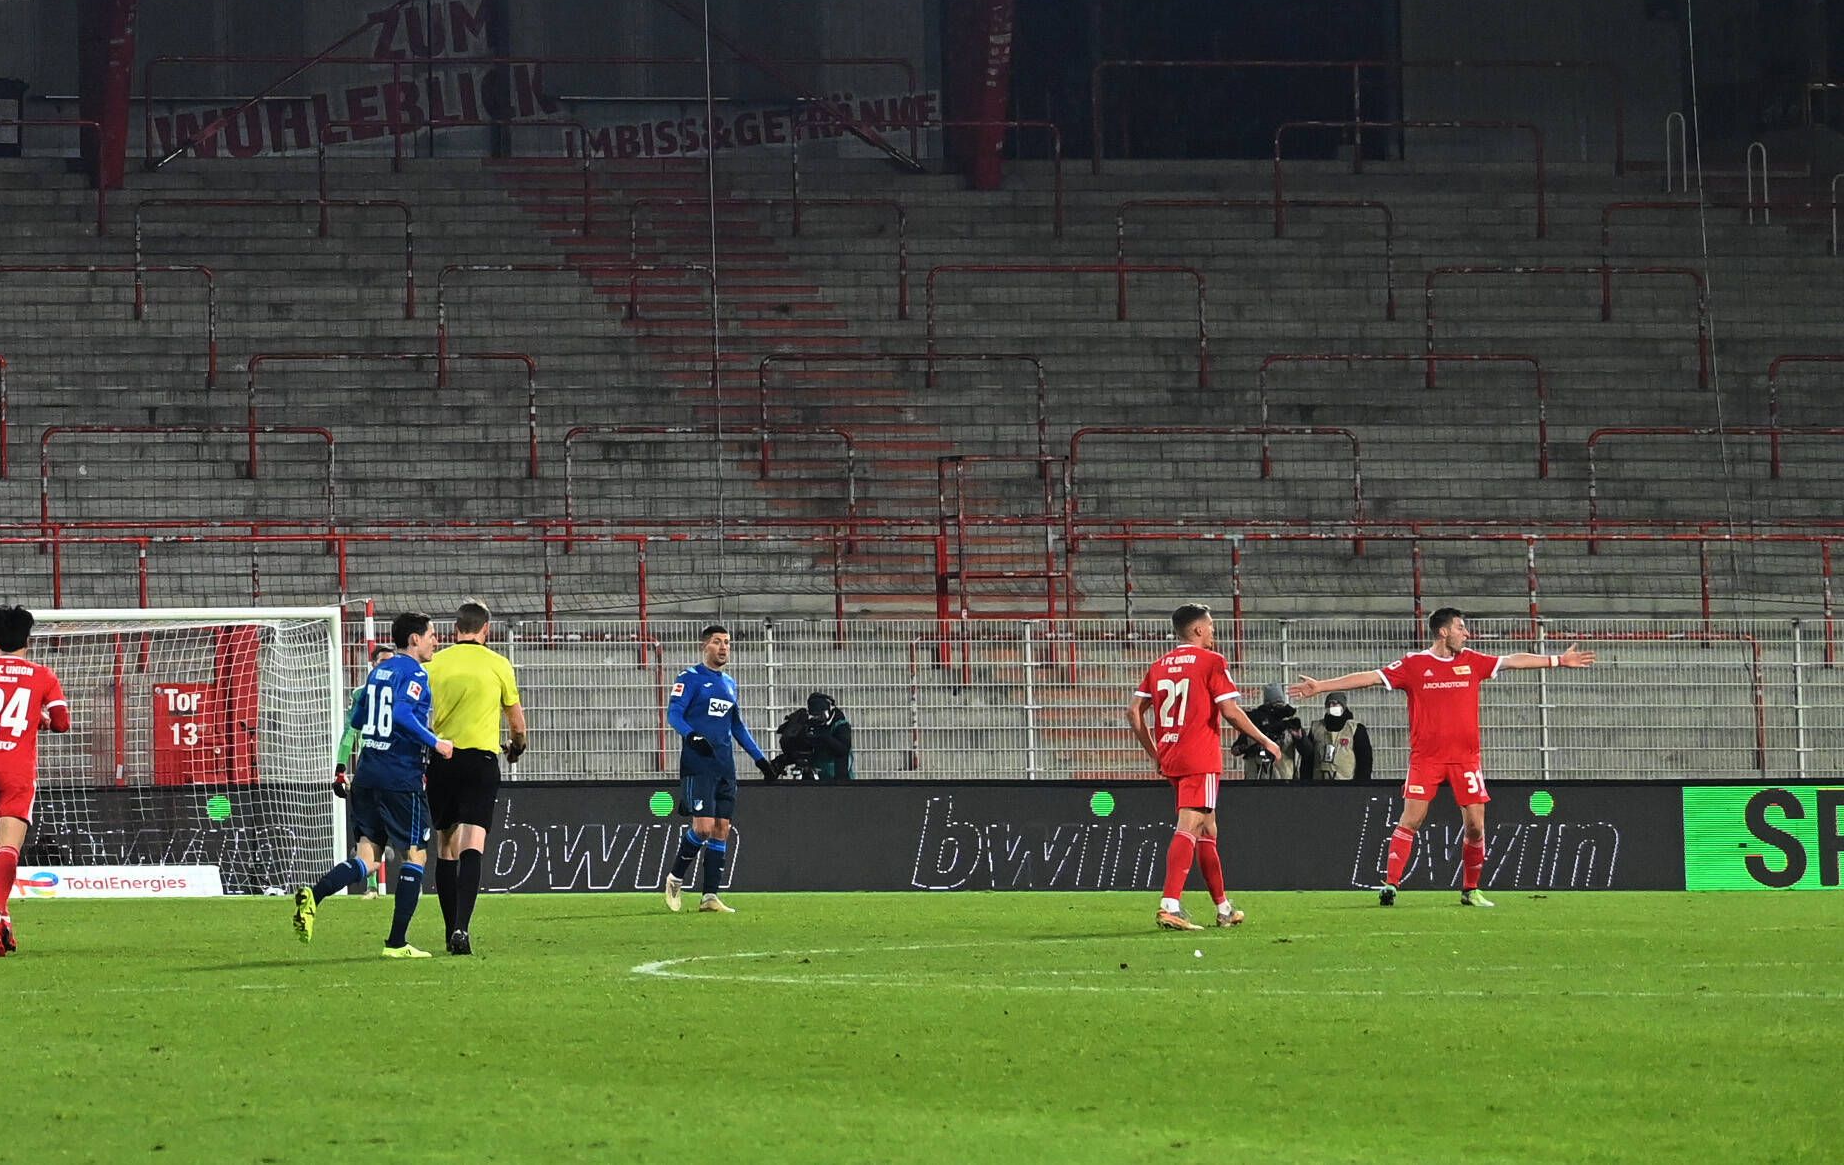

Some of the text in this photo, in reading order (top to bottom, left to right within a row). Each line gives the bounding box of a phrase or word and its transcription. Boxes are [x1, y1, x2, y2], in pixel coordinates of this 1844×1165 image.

[164, 688, 201, 712] Tor
[361, 684, 394, 737] 16
[709, 702, 729, 713] SAP
[1157, 678, 1190, 727] 21
[171, 723, 198, 746] 13
[911, 791, 1172, 890] bwin
[64, 877, 187, 892] TotalEnergies
